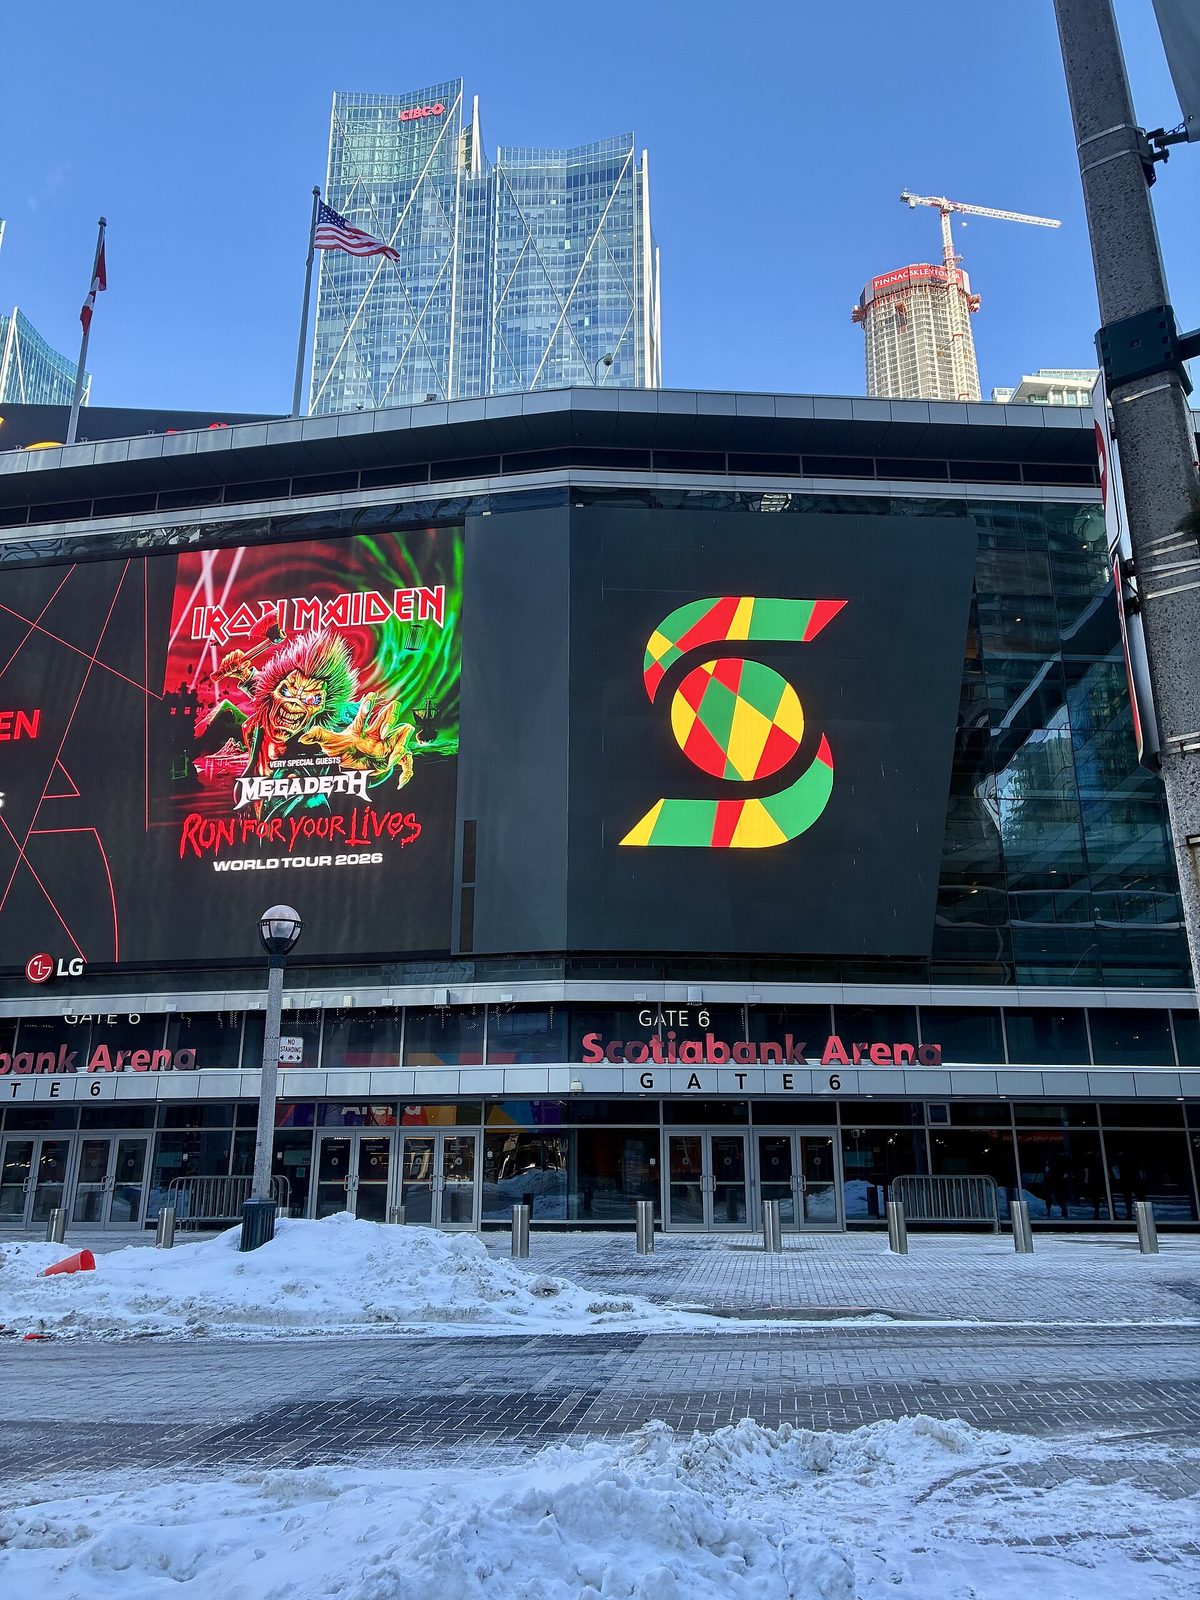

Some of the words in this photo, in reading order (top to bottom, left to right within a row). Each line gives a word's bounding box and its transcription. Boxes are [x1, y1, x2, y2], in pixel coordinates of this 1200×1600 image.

[400, 106, 431, 120] CIBC
[191, 598, 287, 647] IRON
[291, 585, 446, 637] MAIDEN
[269, 759, 287, 769] VERY
[287, 758, 315, 768] SPECIAL
[316, 756, 341, 766] GUESTS
[233, 769, 376, 810] MEGADETH
[180, 813, 236, 859] RUN
[241, 815, 286, 843] FOR
[213, 858, 280, 872] WORLD
[280, 855, 333, 870] TOUR
[335, 853, 383, 866] 2026
[56, 957, 84, 976] LG
[639, 1010, 689, 1027] GATE
[698, 1010, 710, 1028] 6
[287, 1038, 296, 1046] NO
[582, 1031, 808, 1064] Scotiabank
[820, 1035, 942, 1066] Arena
[87, 1044, 198, 1073] Arena
[90, 1081, 101, 1096] 6
[829, 1074, 841, 1091] 6
